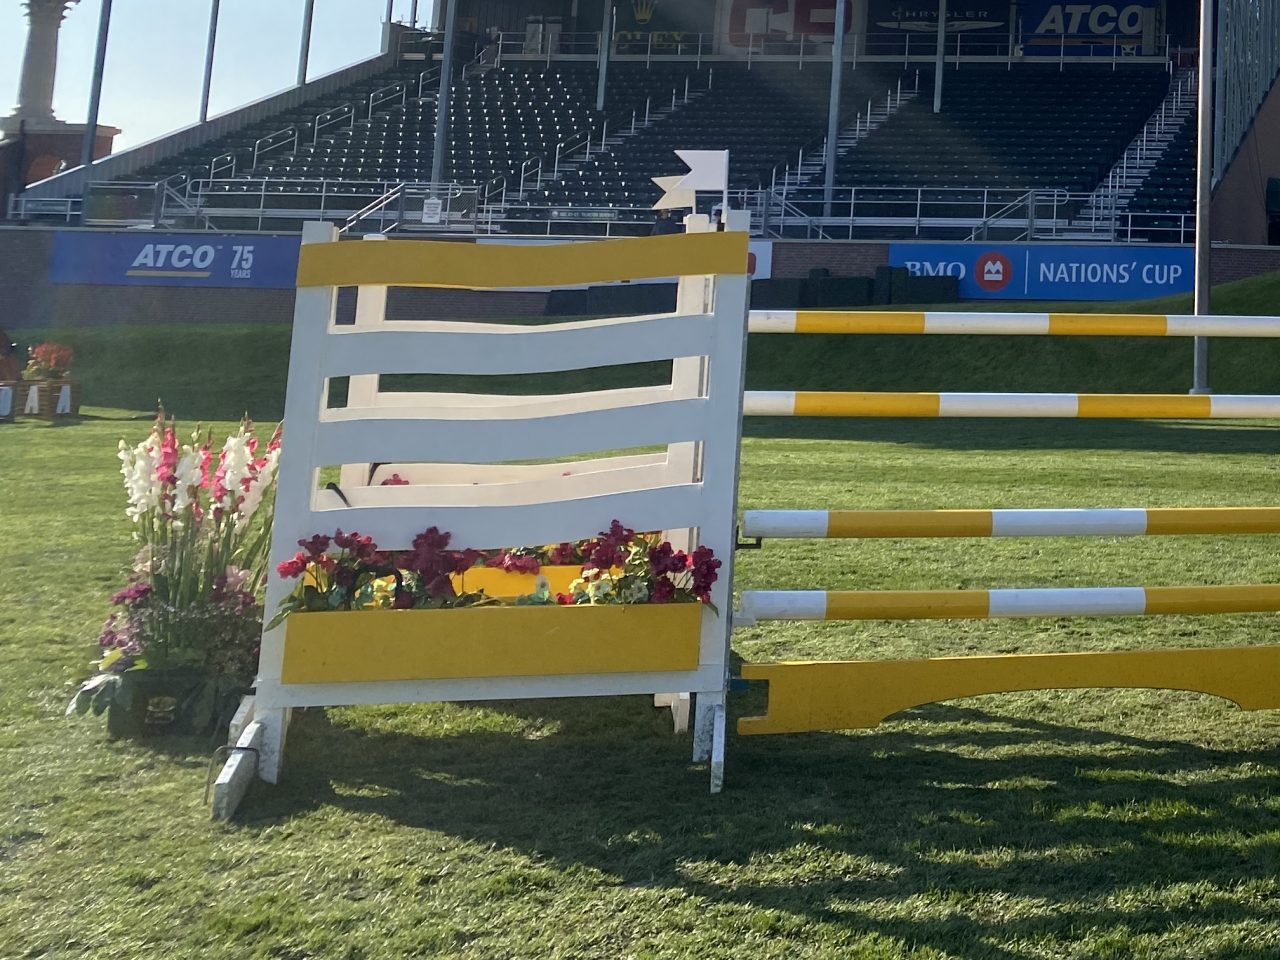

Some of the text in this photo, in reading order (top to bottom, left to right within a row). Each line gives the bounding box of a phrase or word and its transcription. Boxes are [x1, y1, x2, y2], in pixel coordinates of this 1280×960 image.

[1034, 4, 1144, 35] ATCO
[131, 244, 254, 269] ATCO 75
[230, 269, 252, 279] YEARS
[1039, 261, 1137, 284] NATIONS'
[1142, 264, 1183, 285] CUP
